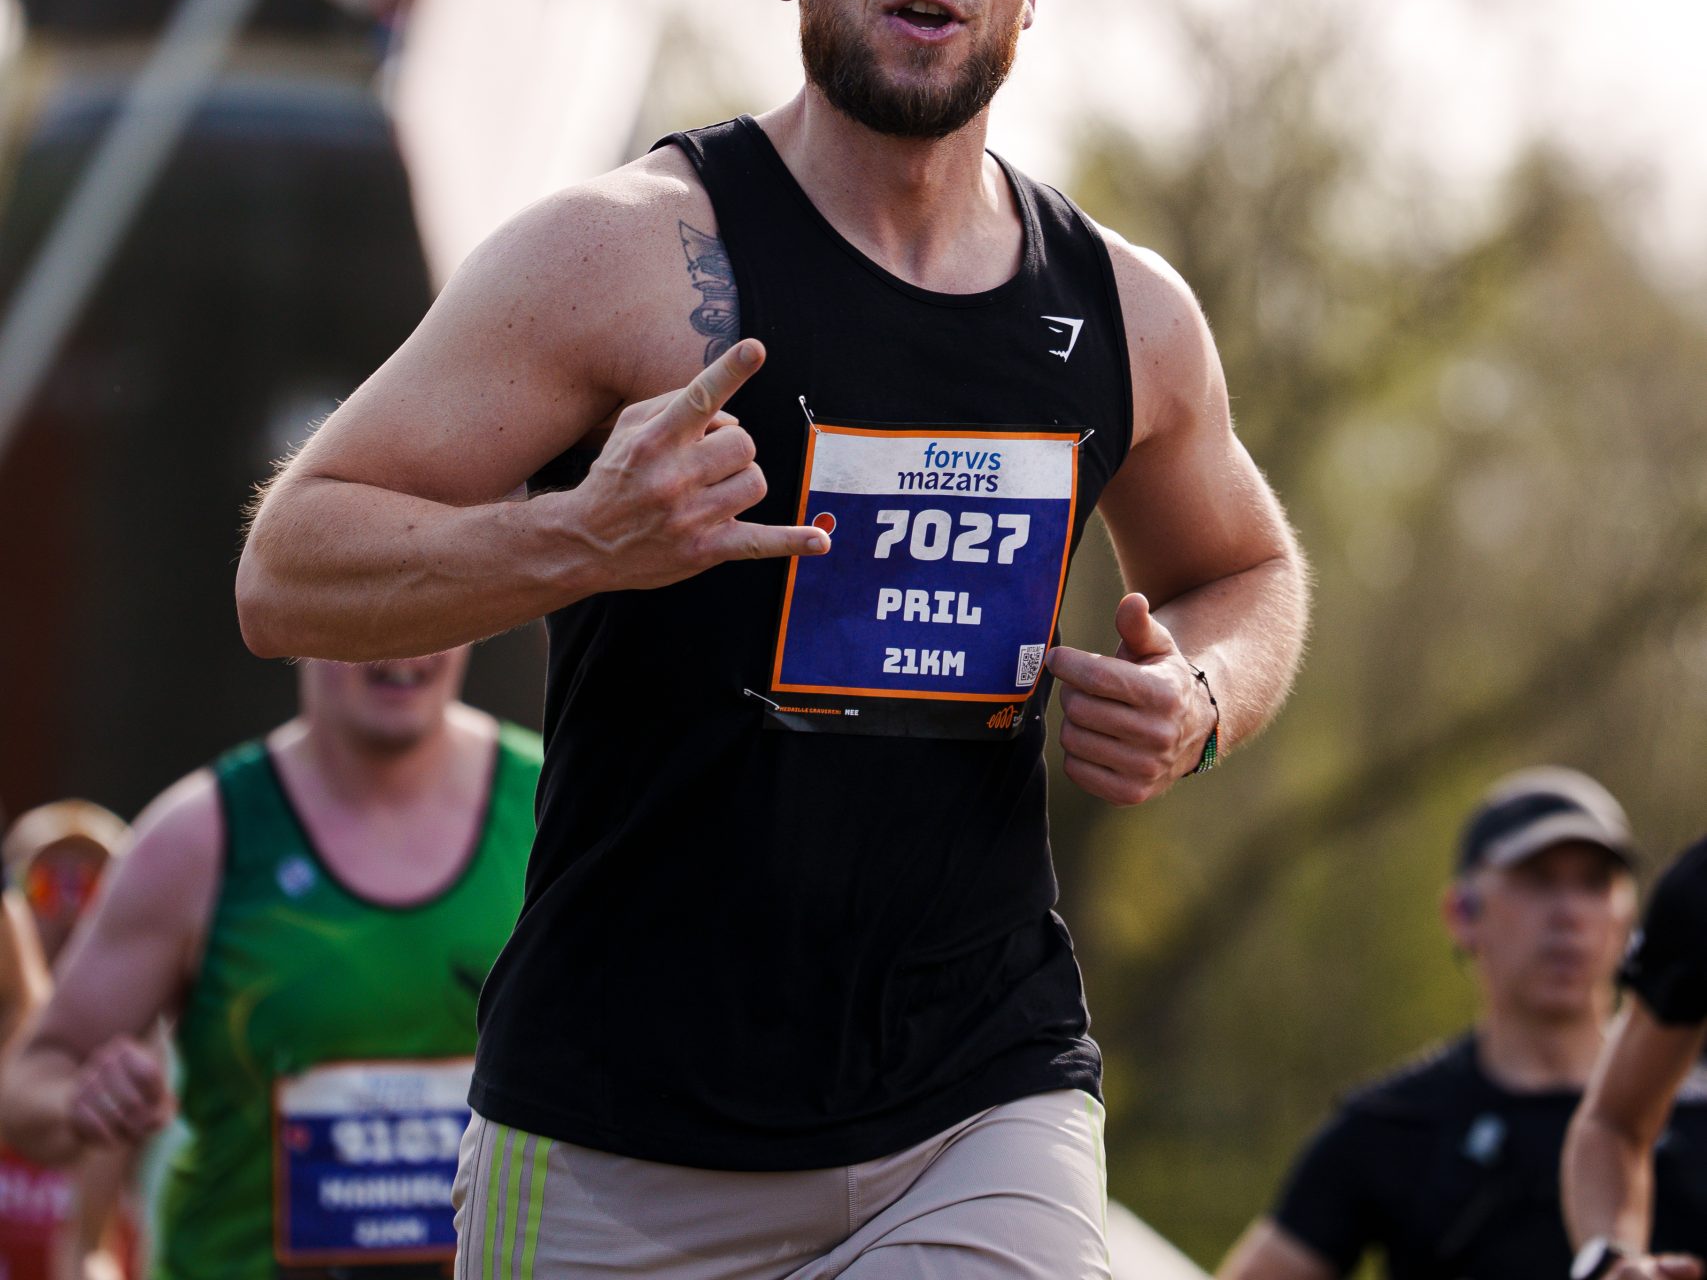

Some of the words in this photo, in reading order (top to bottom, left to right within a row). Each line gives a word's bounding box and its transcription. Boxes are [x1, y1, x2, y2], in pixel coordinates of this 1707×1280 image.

[924, 442, 1002, 470] forvis
[898, 471, 999, 493] mazars
[873, 509, 1031, 565] 7027
[876, 588, 982, 625] PRIL
[882, 647, 966, 677] 21KM
